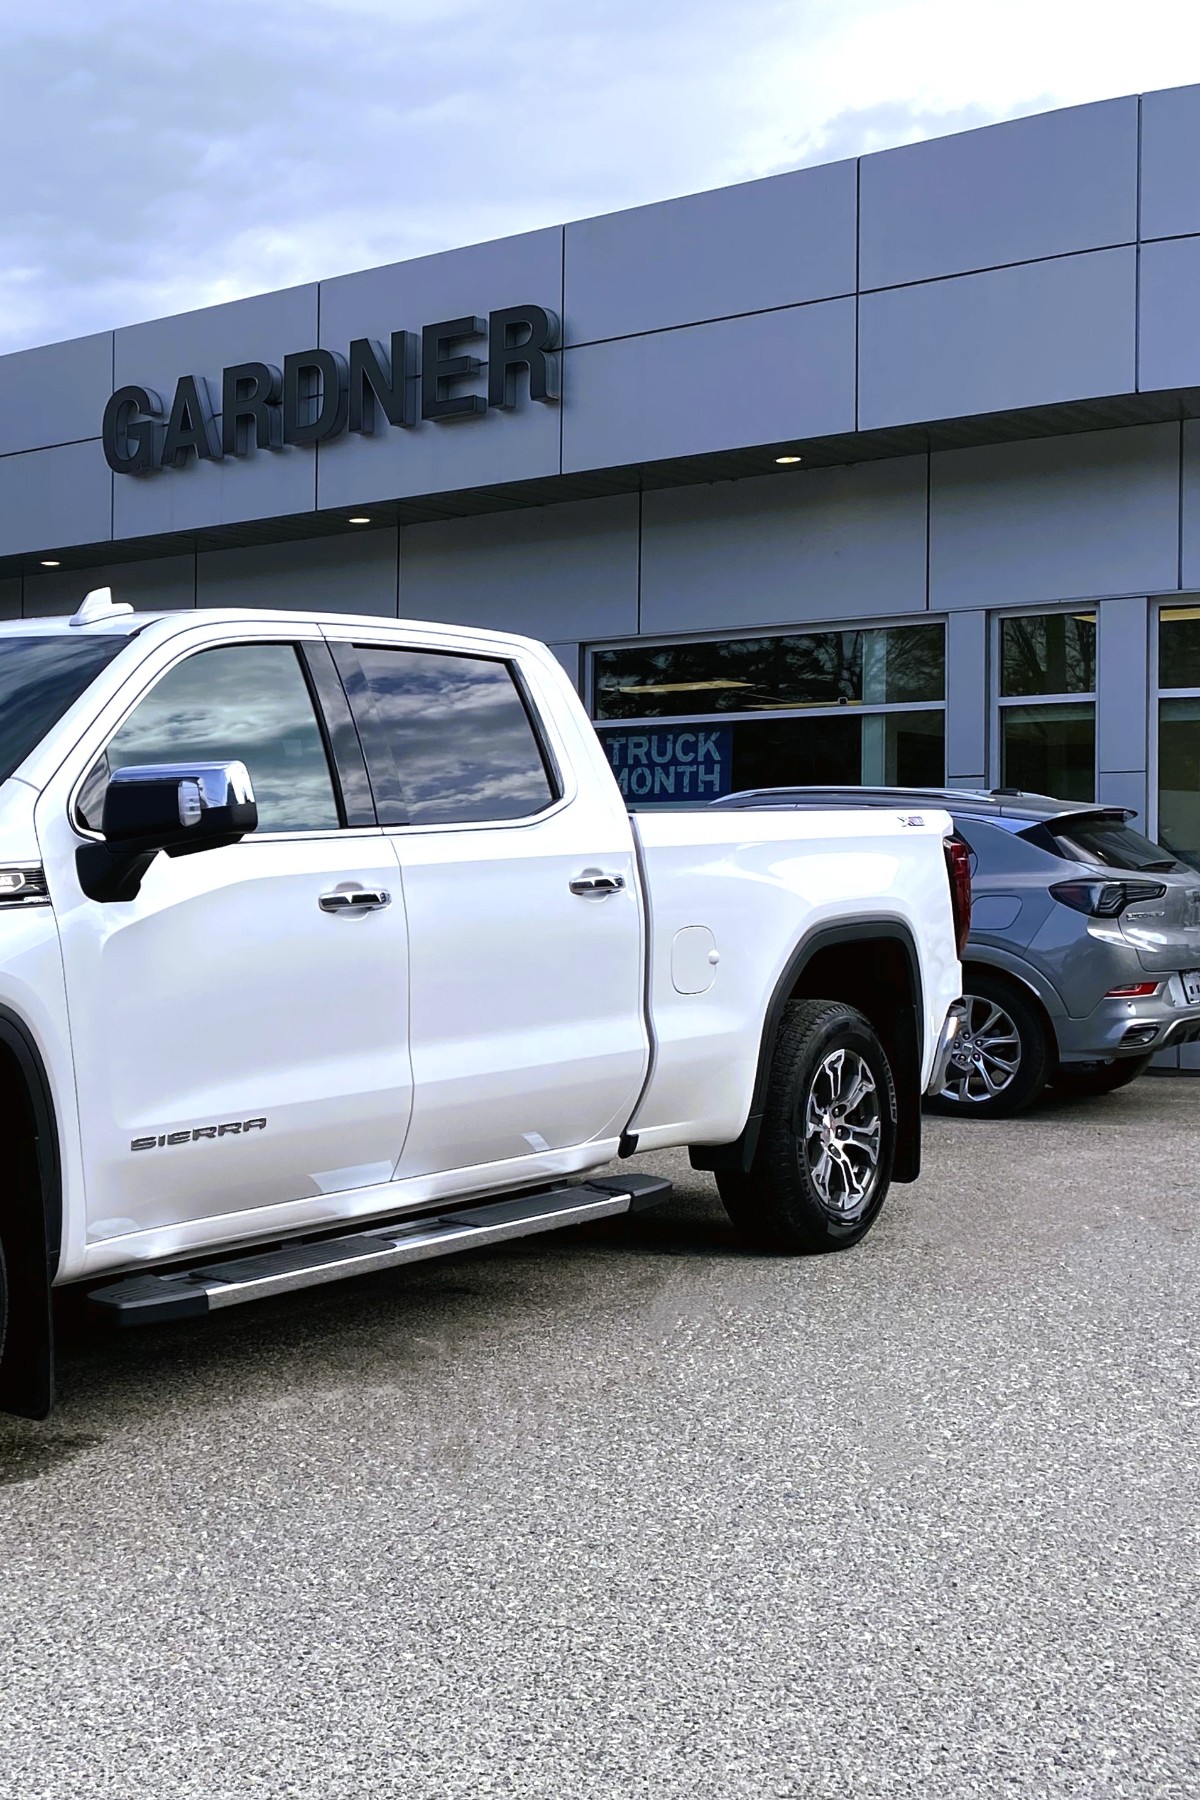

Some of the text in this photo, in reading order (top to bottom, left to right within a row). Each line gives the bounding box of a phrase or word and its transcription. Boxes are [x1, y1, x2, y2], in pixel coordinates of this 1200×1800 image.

[102, 304, 558, 476] GARDNER
[606, 732, 721, 765] TRUCK
[131, 1117, 267, 1151] SIERRA
